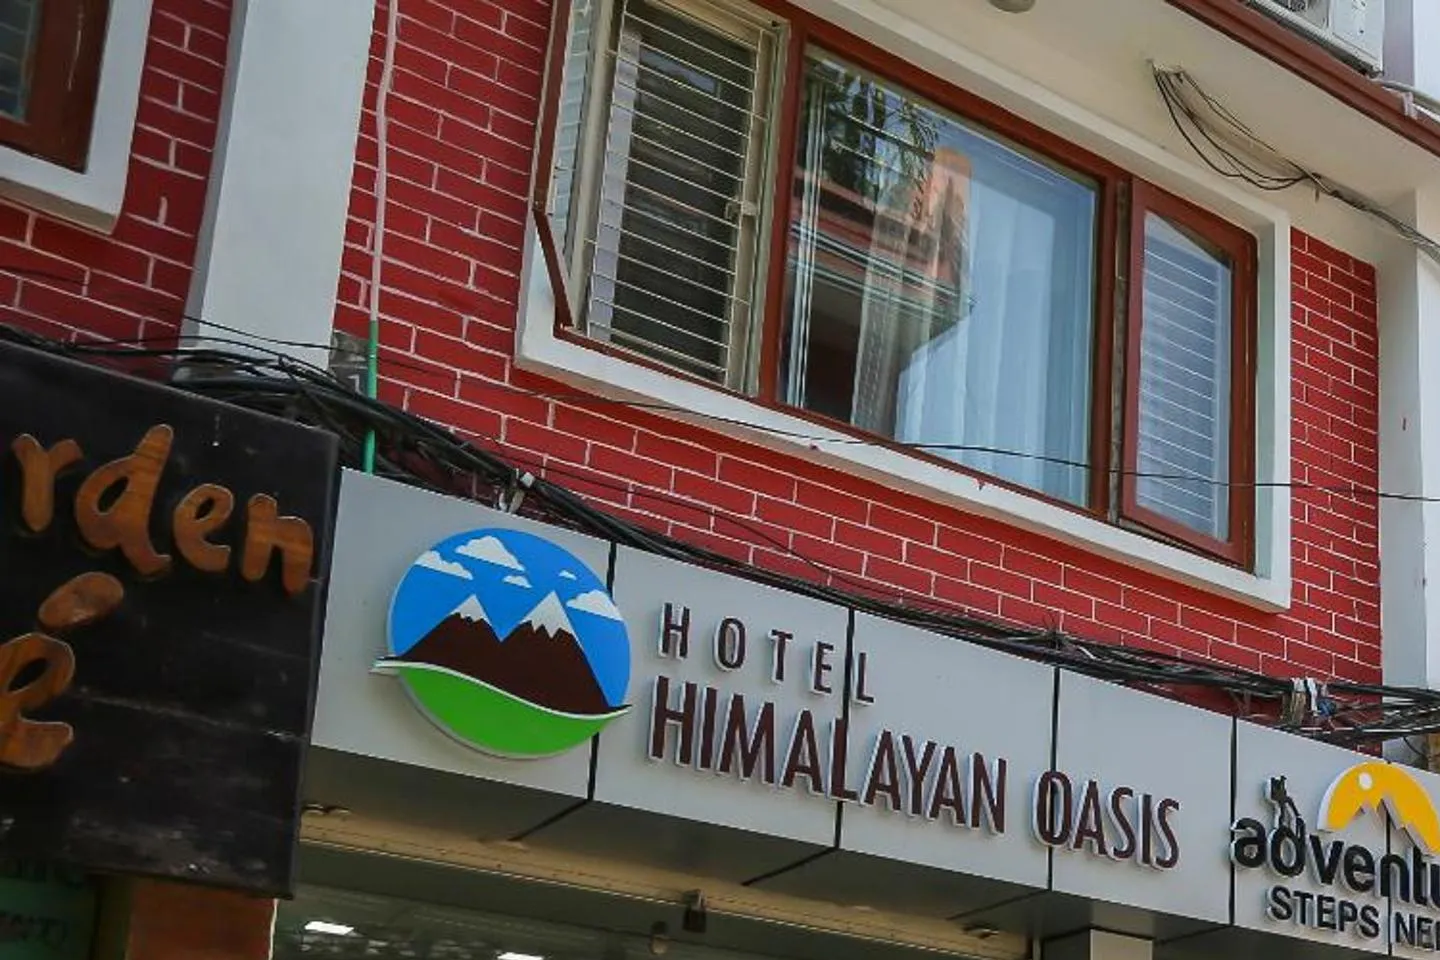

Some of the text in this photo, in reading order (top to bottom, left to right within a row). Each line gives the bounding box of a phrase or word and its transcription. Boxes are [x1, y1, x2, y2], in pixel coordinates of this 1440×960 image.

[657, 601, 876, 705] HOTEL
[648, 674, 1181, 871] HIMALAYAN OASIS
[1266, 884, 1381, 941] STEPS
